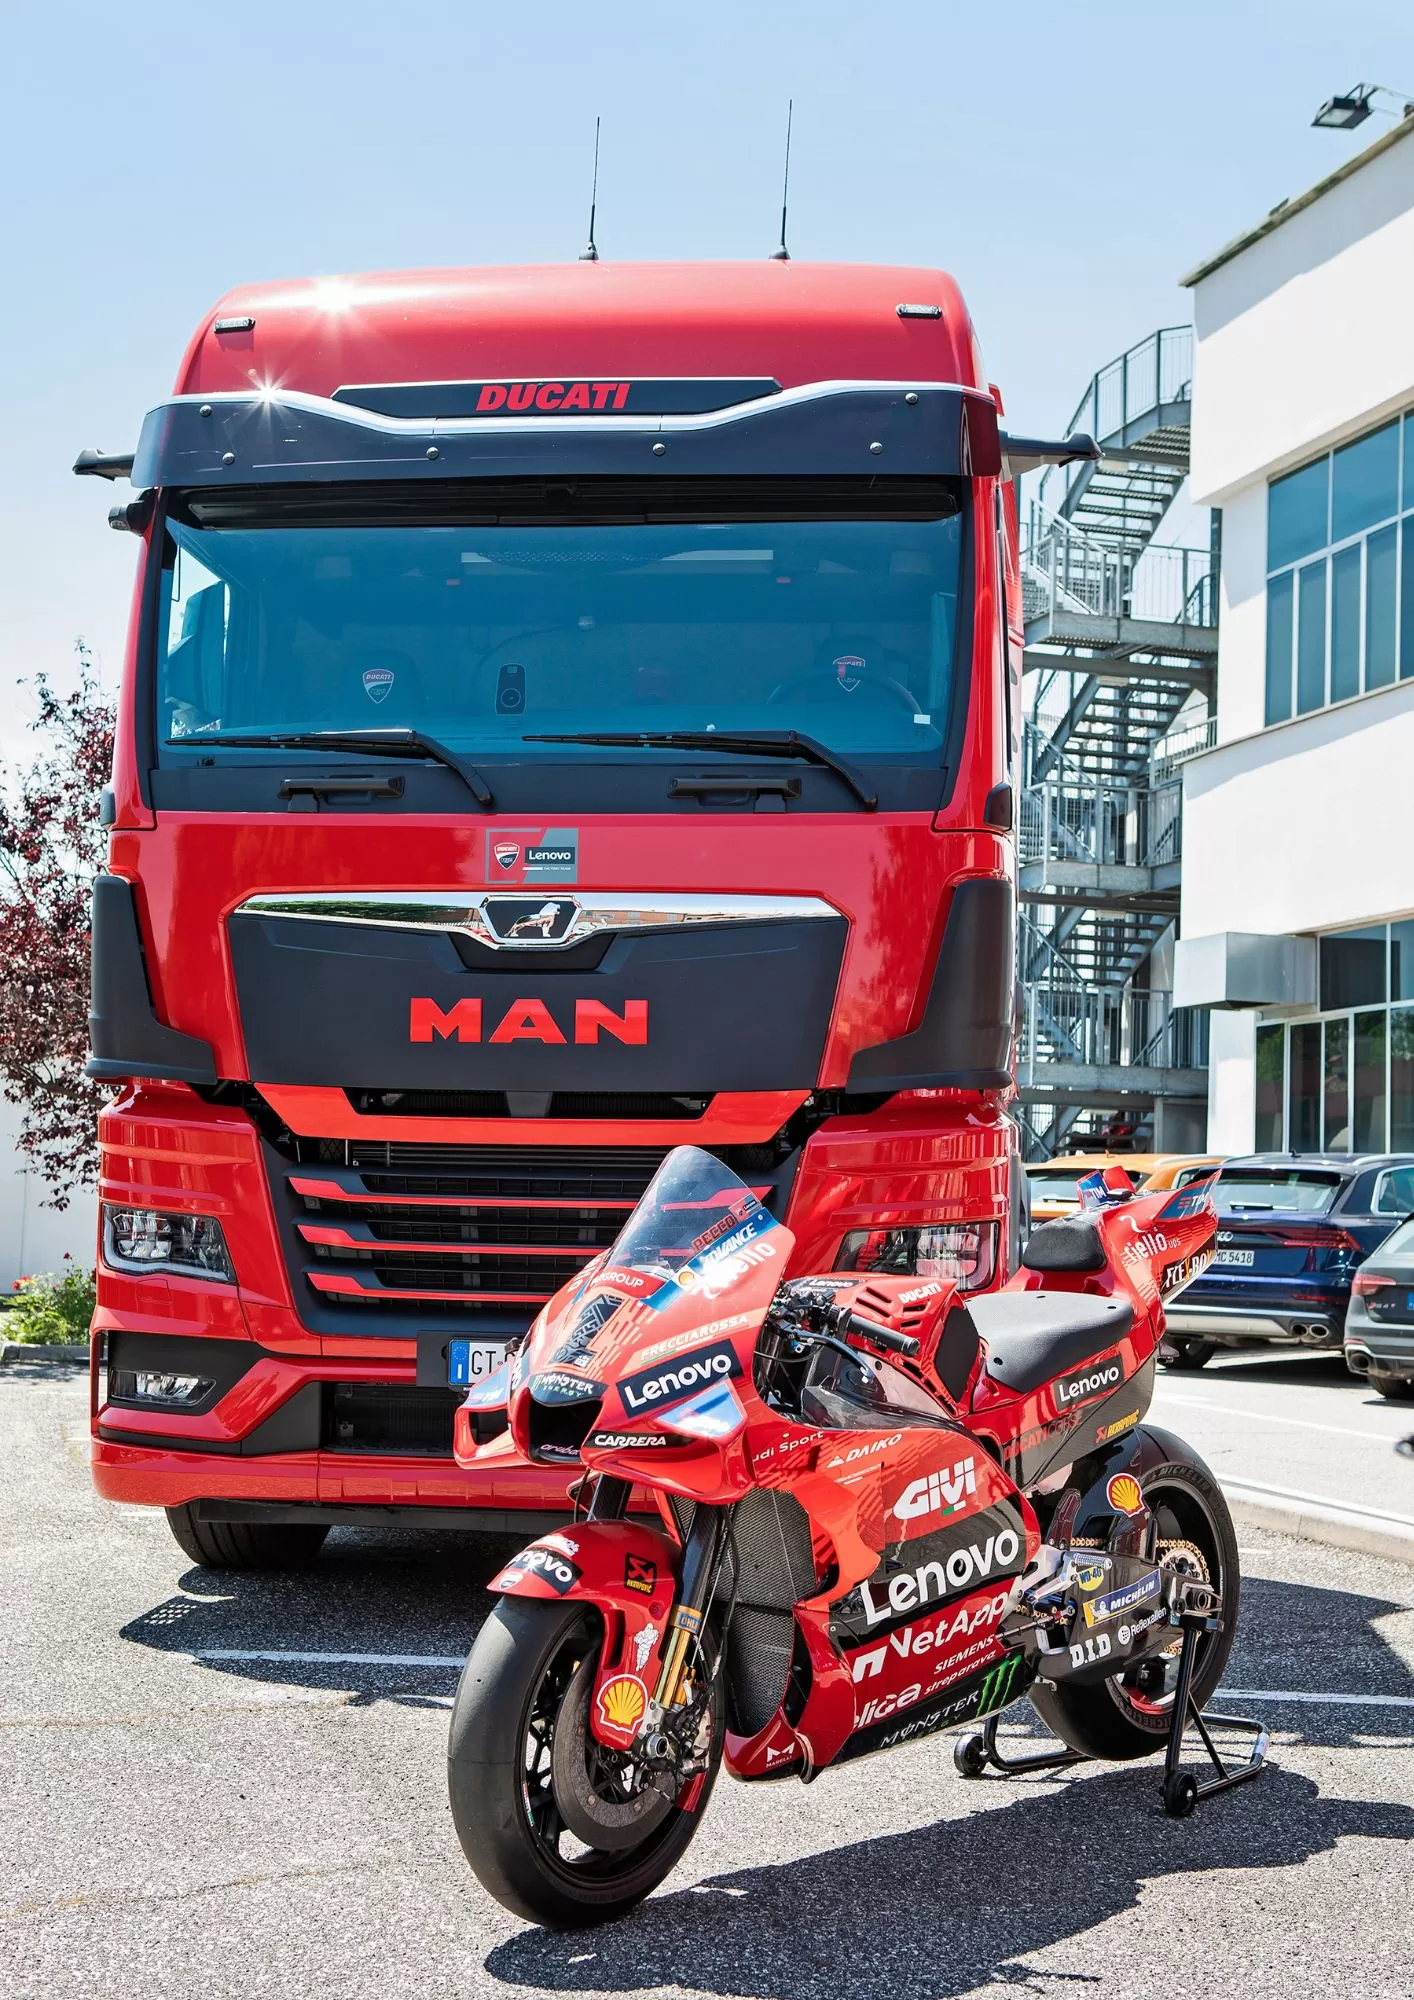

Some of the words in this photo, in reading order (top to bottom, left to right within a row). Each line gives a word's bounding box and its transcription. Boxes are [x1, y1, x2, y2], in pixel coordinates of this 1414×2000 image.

[476, 383, 631, 411] DUCATI
[529, 850, 571, 860] Lenovo
[409, 997, 648, 1045] MAN
[1089, 1186, 1107, 1200] TIM
[692, 1215, 738, 1252] PECCO
[1168, 1238, 1181, 1249] ups
[1229, 1252, 1253, 1264] 5418
[898, 1282, 942, 1304] DUCATI
[641, 1315, 748, 1361] FRECCIAROSSA
[624, 1355, 732, 1408] Lenovo
[1059, 1367, 1120, 1402] Lenovo
[594, 1434, 667, 1447] CARRERA
[779, 1431, 824, 1453] Sport
[1003, 1425, 1048, 1462] DUCATI
[893, 1456, 977, 1520] GIVI
[860, 1529, 1019, 1626] Lenovo
[1079, 1567, 1102, 1585] WD-40
[1110, 1580, 1155, 1611] MICHELIN
[1131, 1607, 1167, 1637] Reflexallen
[934, 1634, 995, 1675] SIEMENS
[1069, 1633, 1112, 1669] D.I.D
[924, 1650, 996, 1695] streparava
[765, 1755, 792, 1768] MARELLI
